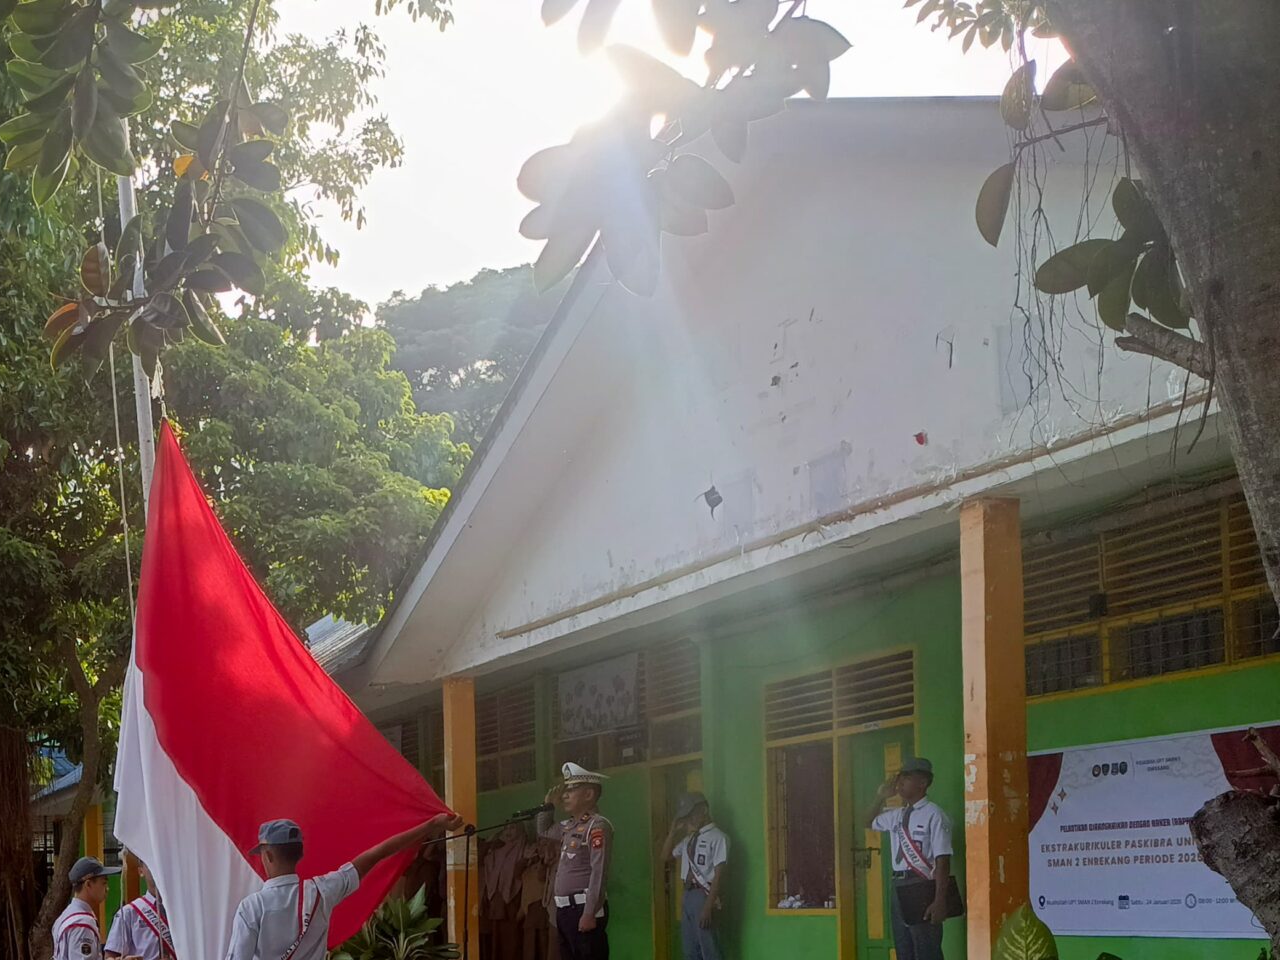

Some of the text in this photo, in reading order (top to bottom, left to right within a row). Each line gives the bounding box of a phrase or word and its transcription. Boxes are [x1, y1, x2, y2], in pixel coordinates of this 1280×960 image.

[1040, 840, 1122, 853] EKSTRAKURIKULER
[1124, 838, 1173, 849] PASKIBRA
[1047, 857, 1072, 868] SMAN
[1075, 857, 1080, 867] 2
[1083, 855, 1131, 866] ENREKANG
[1133, 853, 1175, 865] PERIODE
